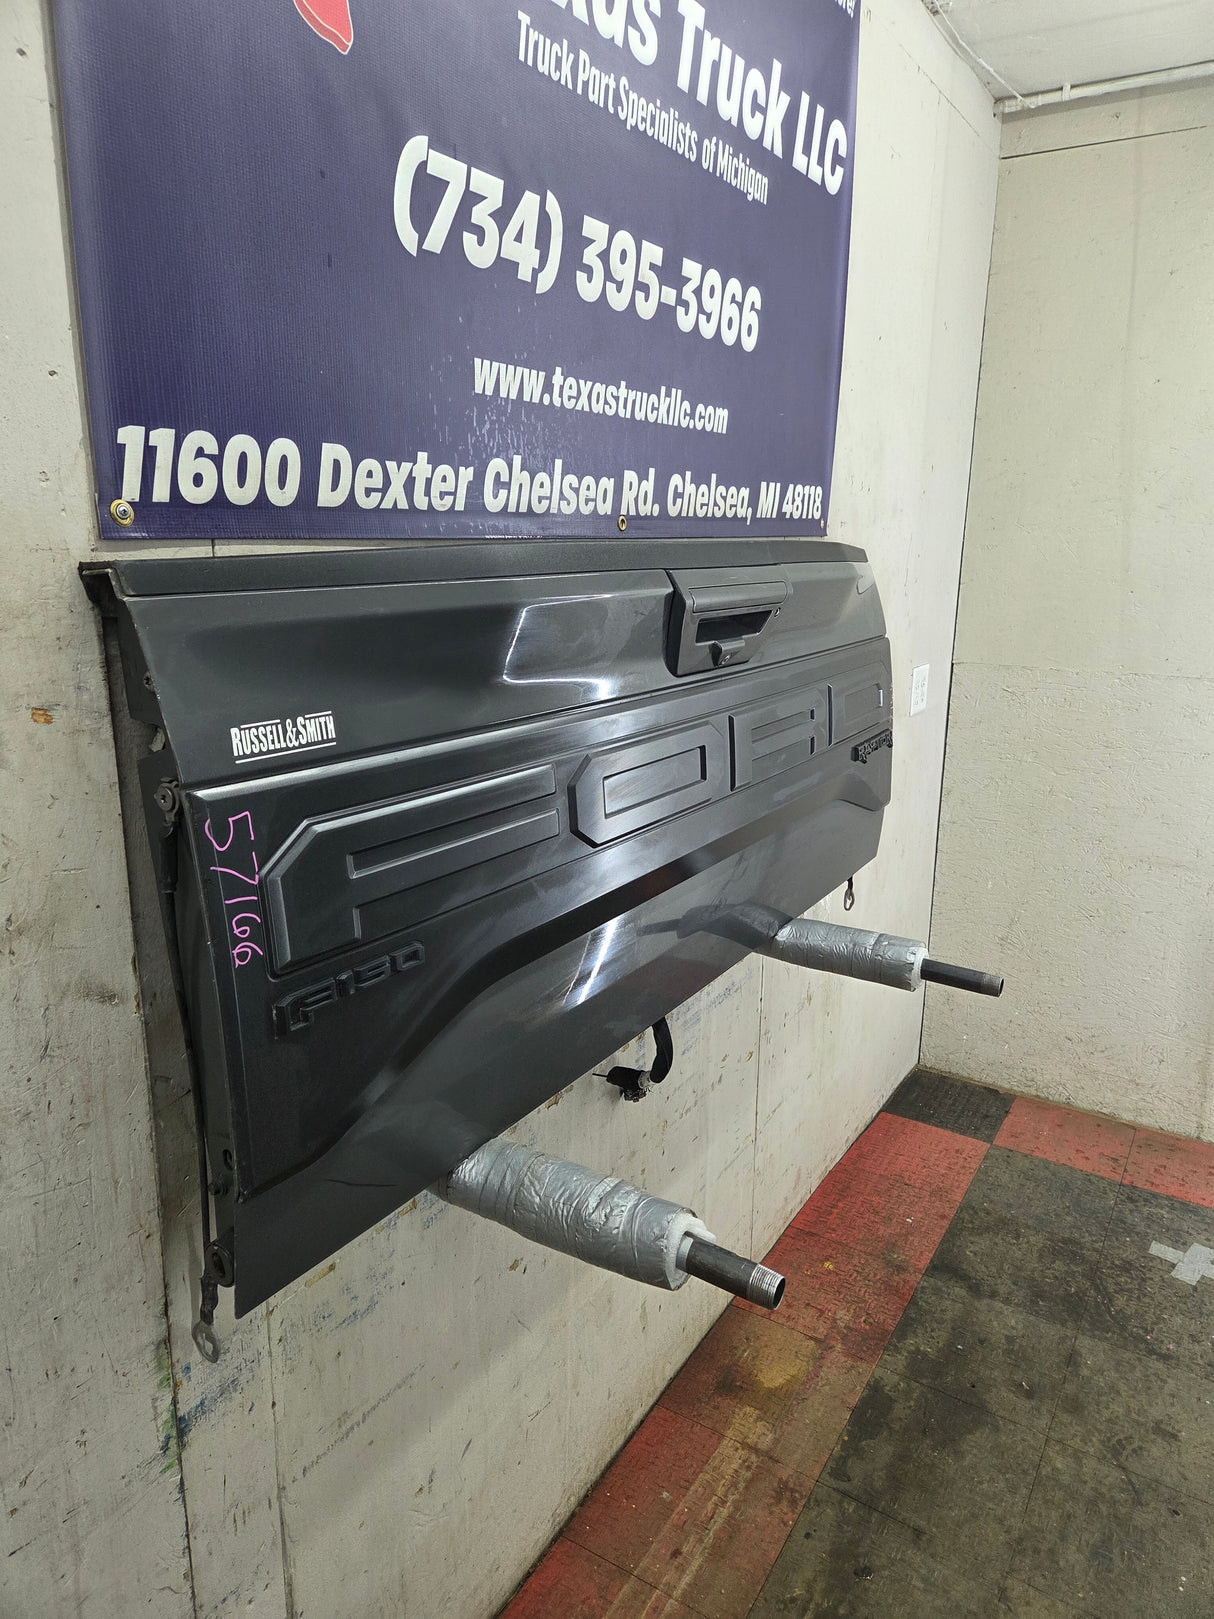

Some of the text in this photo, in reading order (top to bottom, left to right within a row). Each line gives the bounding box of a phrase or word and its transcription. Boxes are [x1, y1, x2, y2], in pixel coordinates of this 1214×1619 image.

[517, 10, 769, 205] Truck Part Specialists of Michigan
[677, 0, 791, 159] Truck
[792, 91, 848, 196] LLC
[393, 134, 762, 352] (734) 395-3966
[117, 425, 823, 525] 11600 Dexter Chelsea Rd. Chelsea, MI 48118
[474, 357, 729, 434] www.texastruckllc.com
[204, 811, 264, 968] 57166
